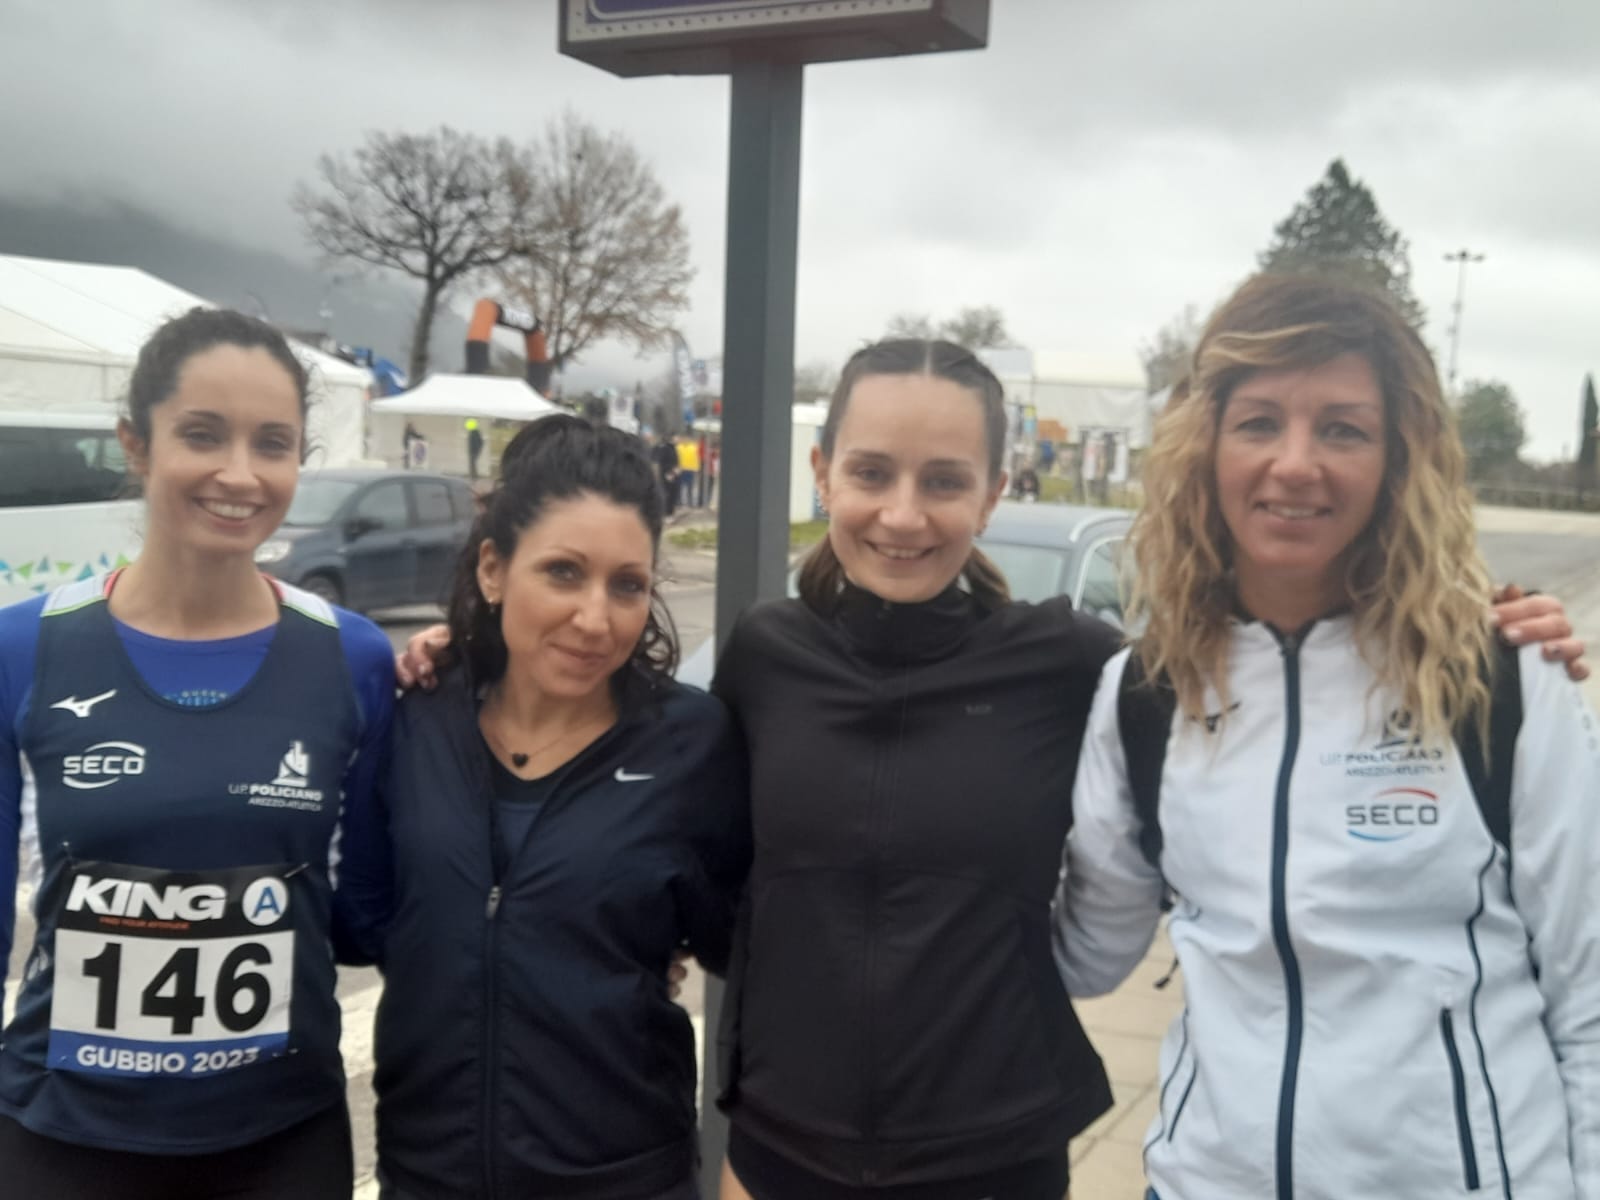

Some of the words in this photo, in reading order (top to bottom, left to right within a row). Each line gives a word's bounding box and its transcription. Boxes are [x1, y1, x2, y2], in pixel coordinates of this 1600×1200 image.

[63, 755, 144, 775] SECO
[1346, 805, 1438, 825] SECO
[65, 874, 227, 922] KING
[251, 886, 281, 919] A
[82, 942, 272, 1036] 146
[76, 1044, 186, 1074] GUBBIO
[190, 1047, 261, 1073] 2023
